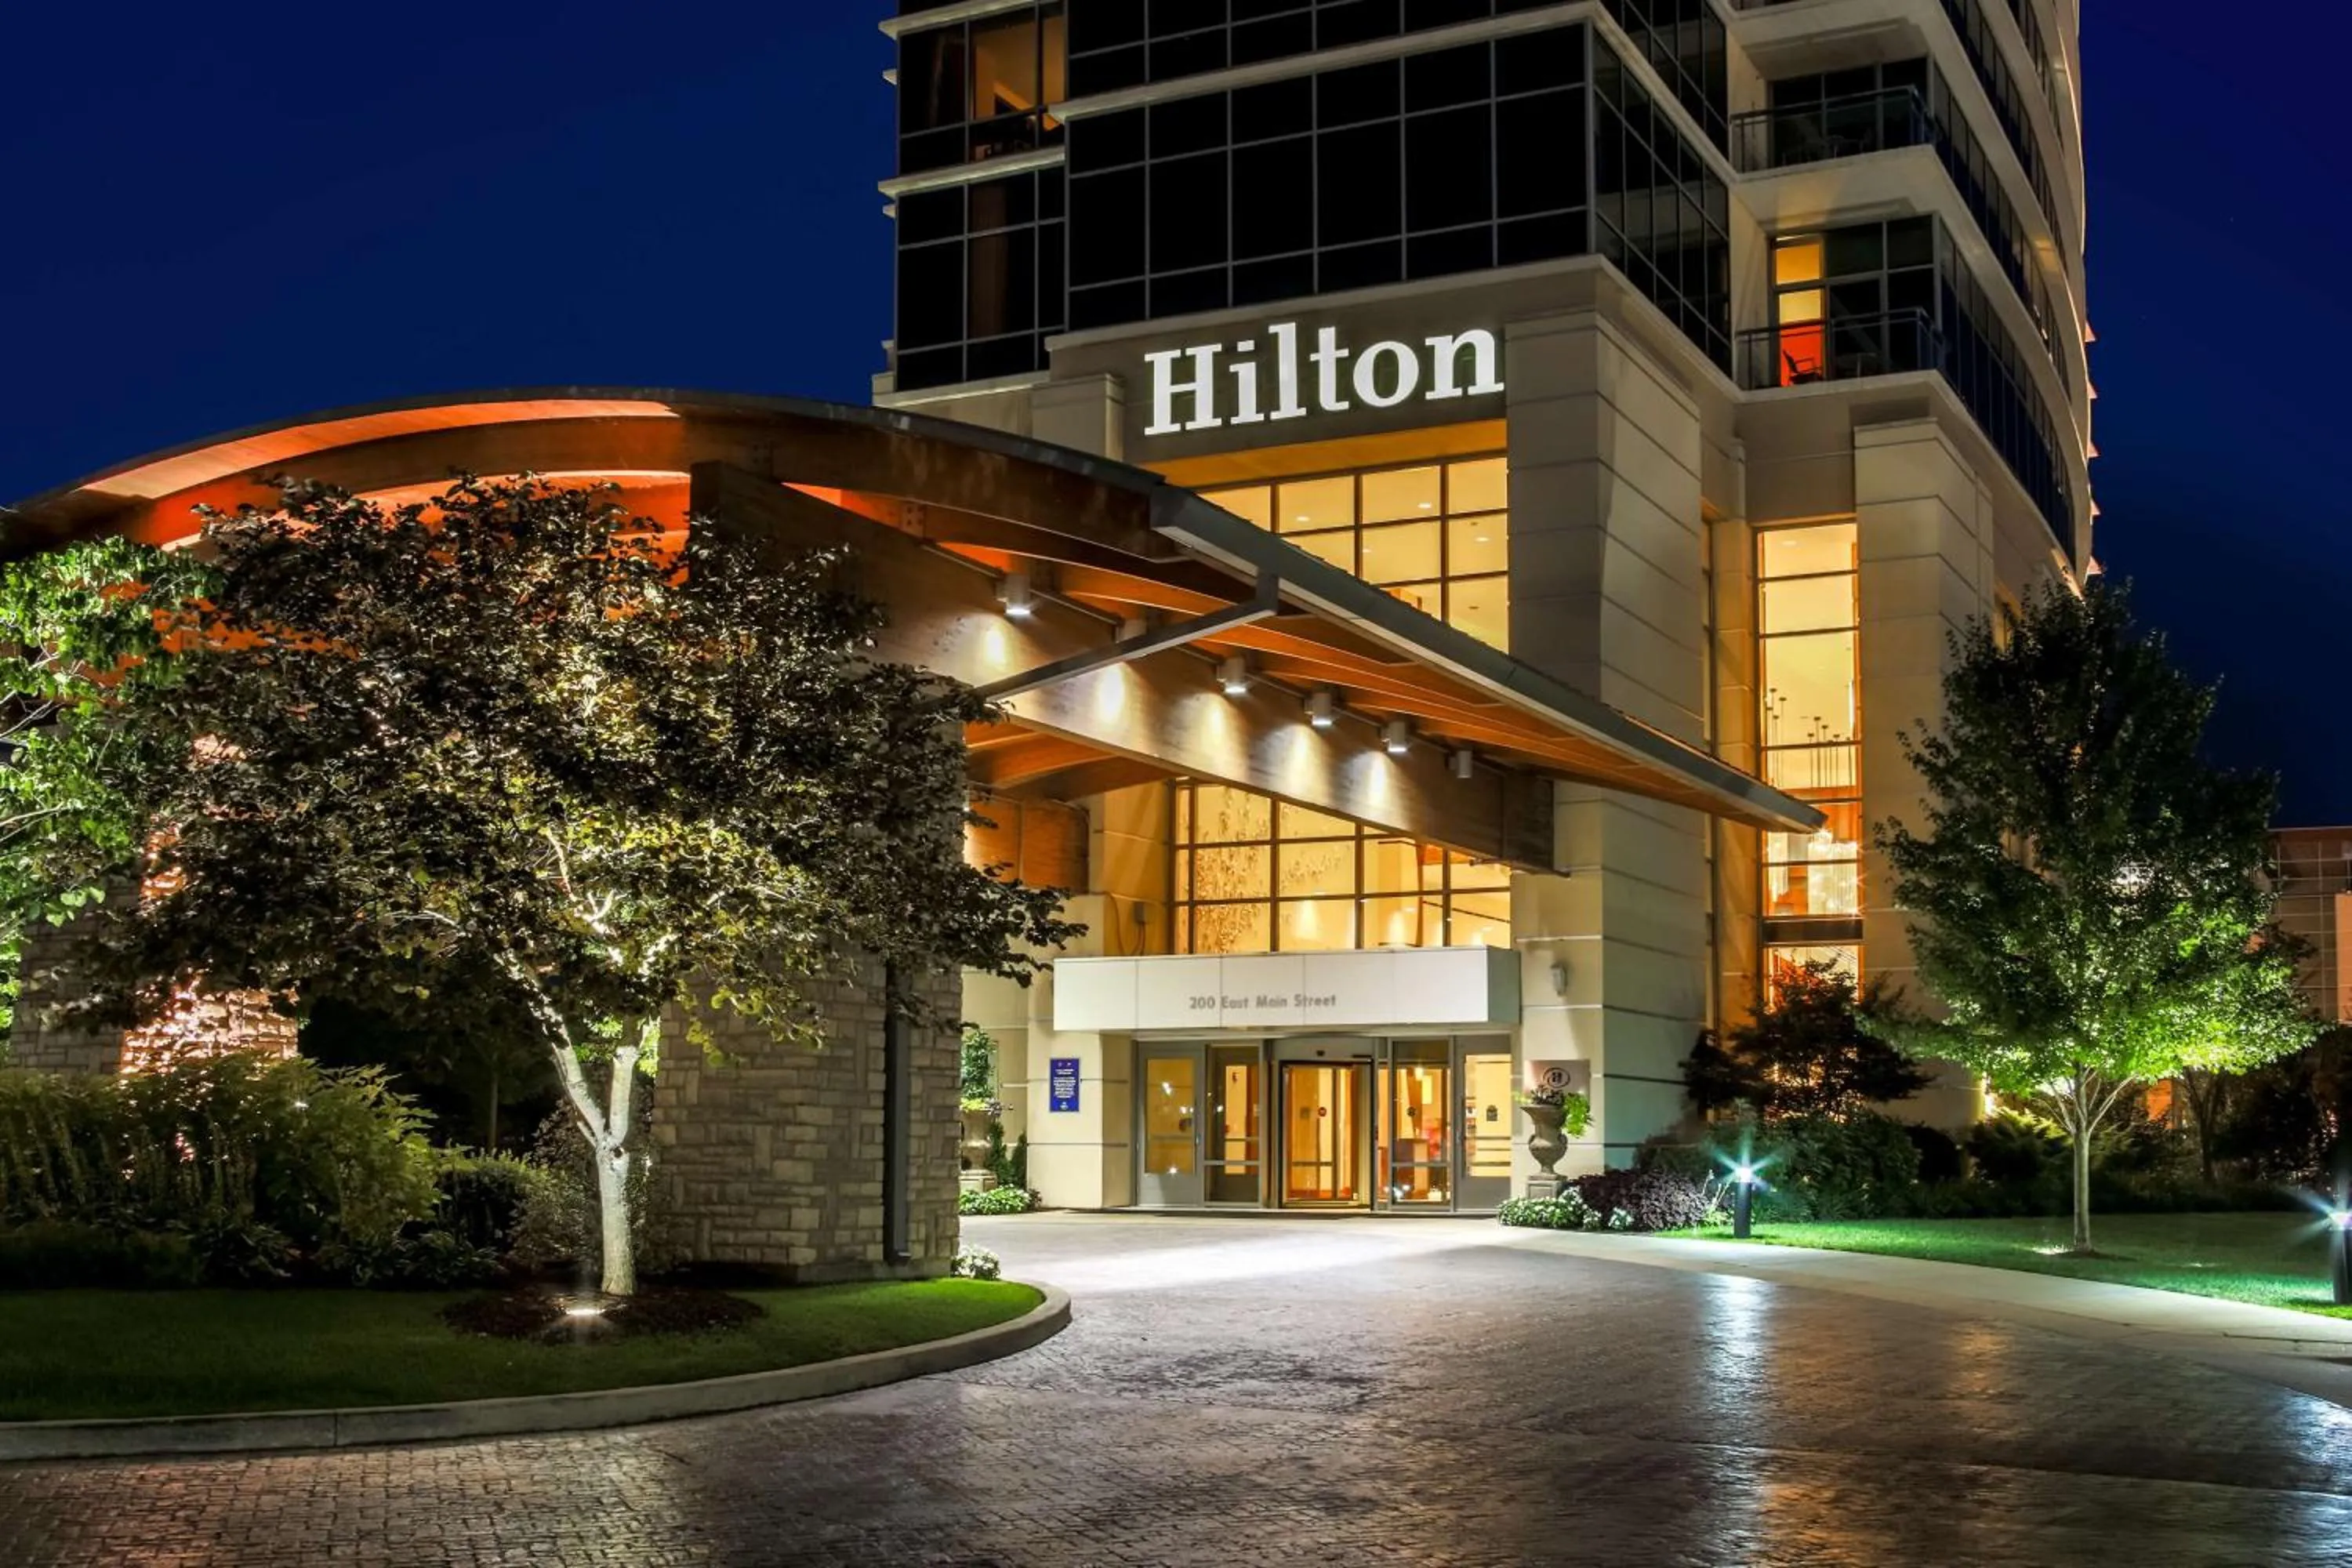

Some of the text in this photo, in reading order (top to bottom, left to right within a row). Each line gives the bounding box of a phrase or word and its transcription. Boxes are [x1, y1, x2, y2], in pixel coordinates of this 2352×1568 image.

[1144, 321, 1504, 436] Hilton
[1189, 993, 1337, 1010] 200 East Main Street
